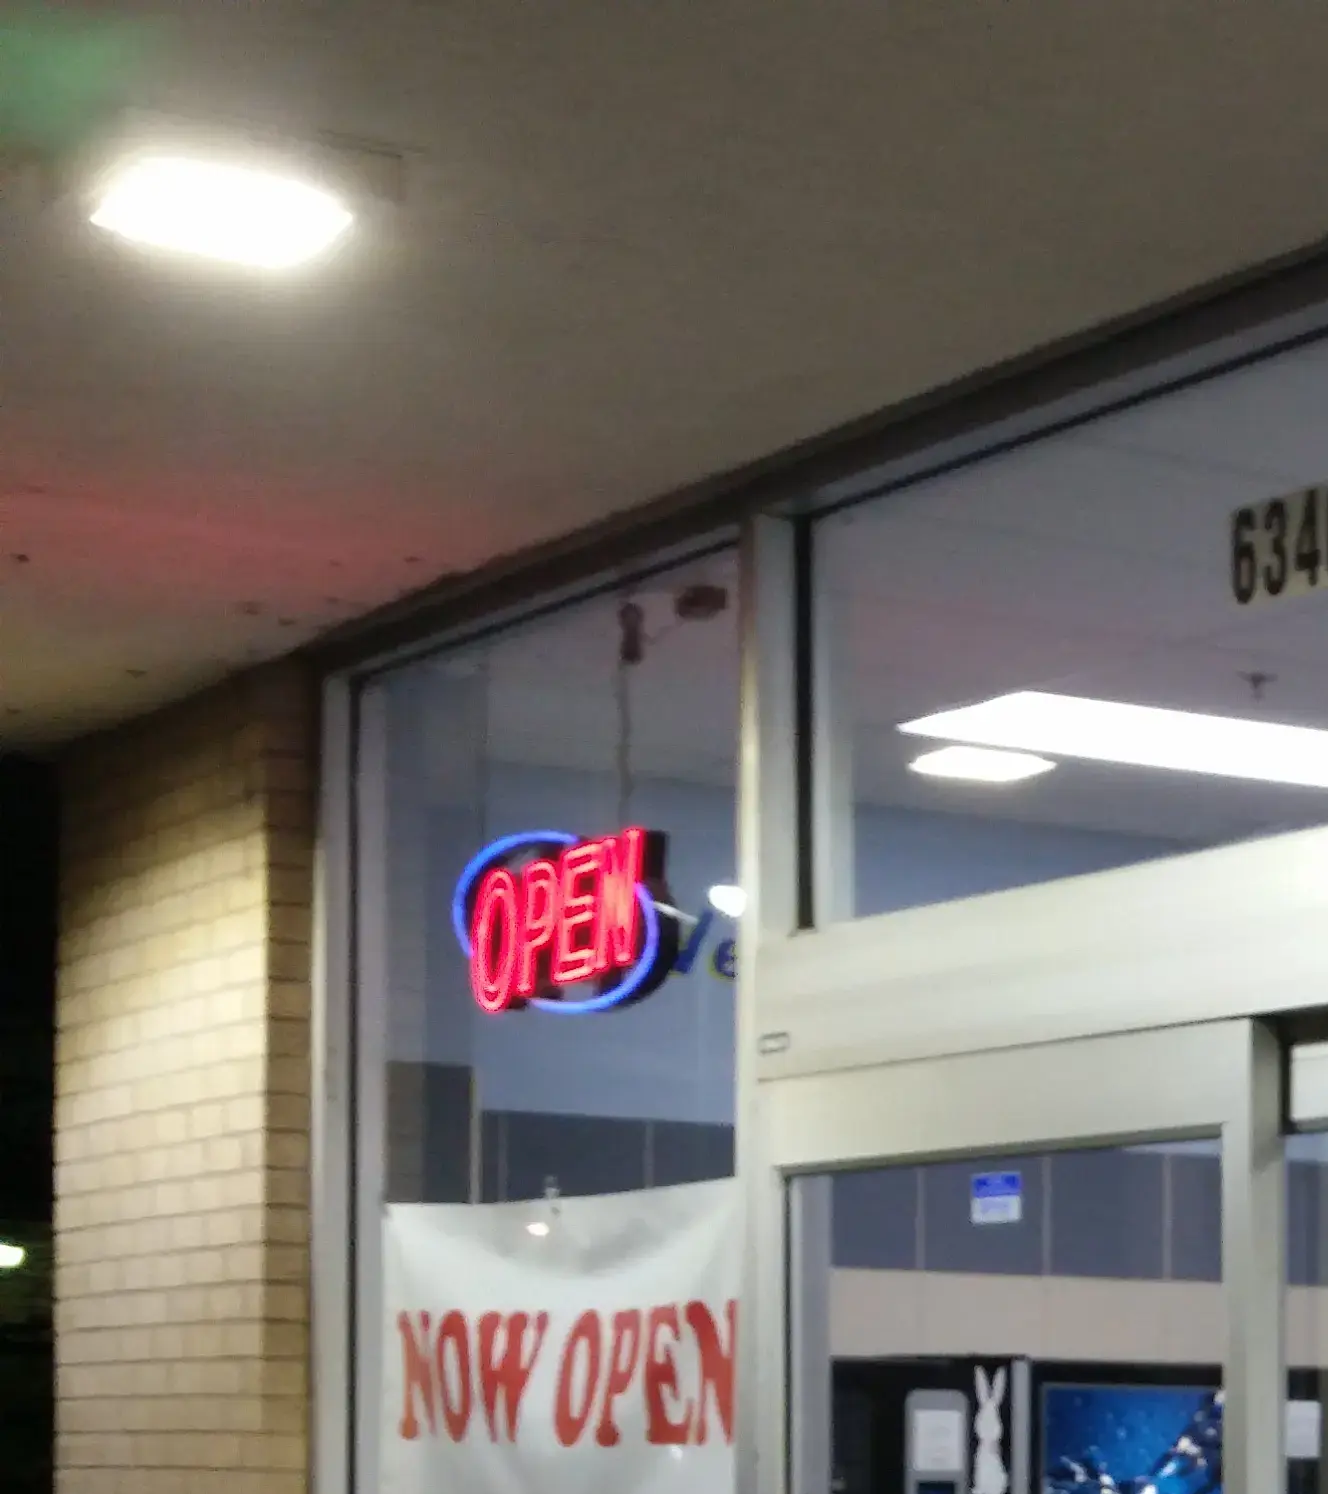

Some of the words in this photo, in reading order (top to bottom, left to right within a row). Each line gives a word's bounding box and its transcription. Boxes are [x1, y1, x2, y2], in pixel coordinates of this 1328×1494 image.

[470, 827, 645, 1012] OPEN
[398, 1308, 549, 1443] NOW
[555, 1299, 738, 1447] OPEN
